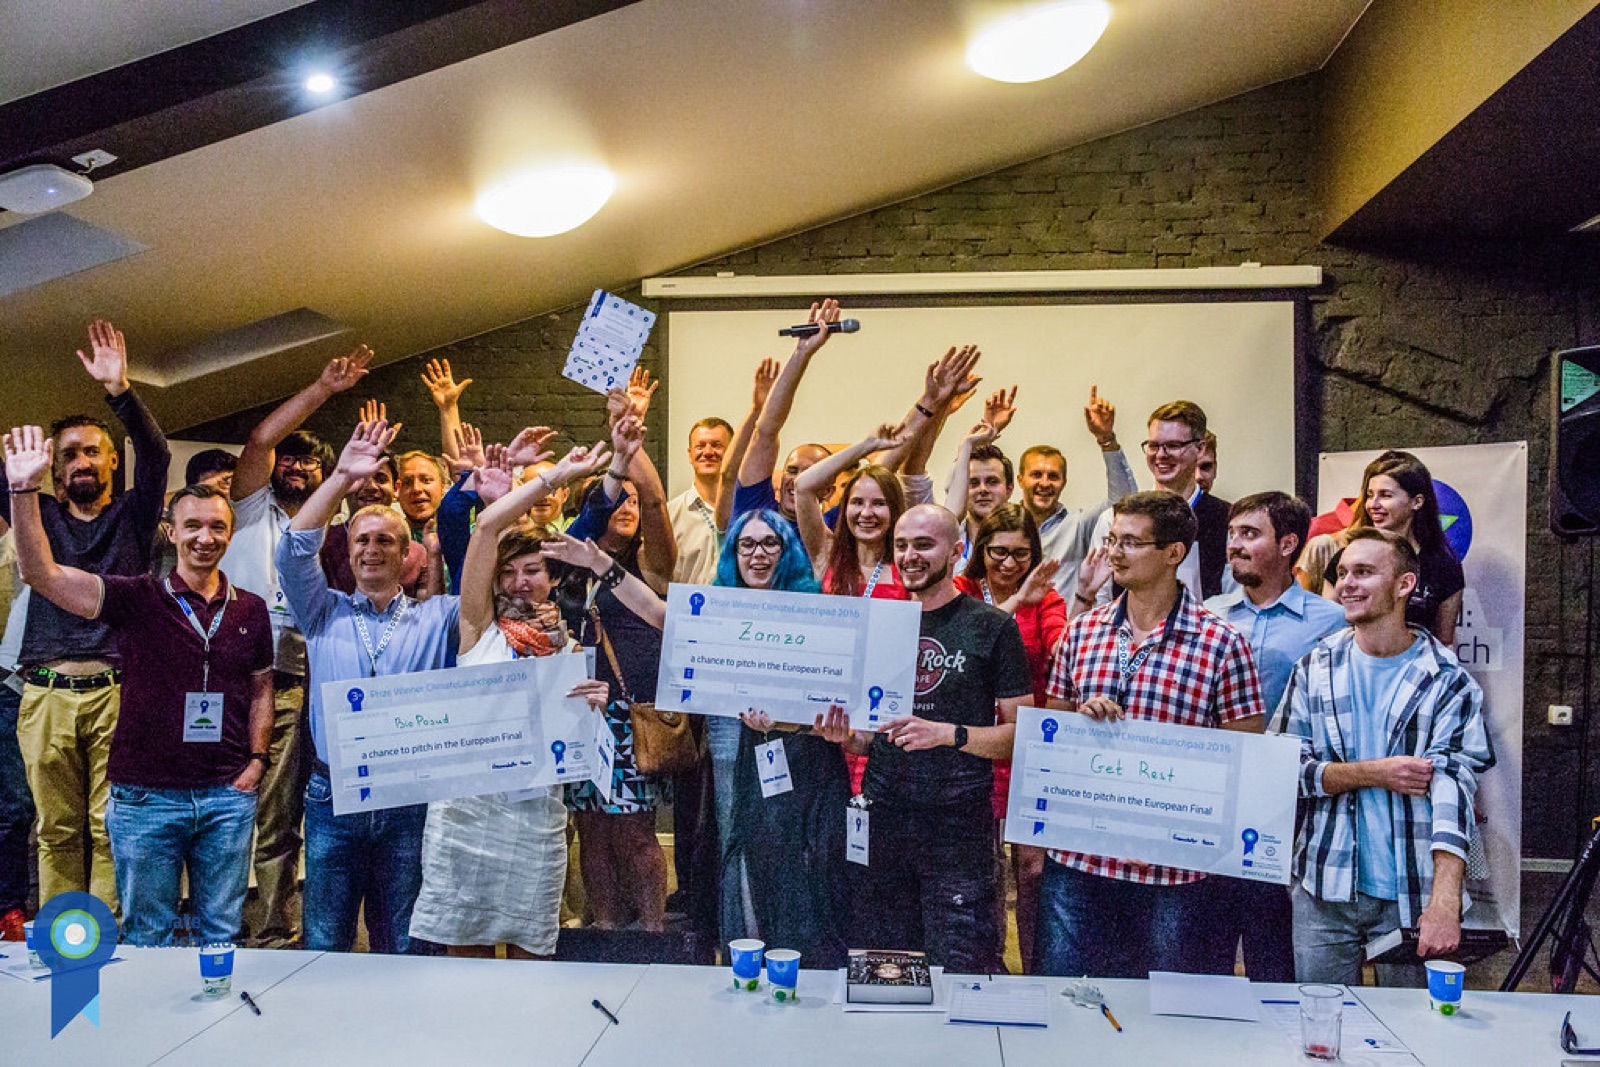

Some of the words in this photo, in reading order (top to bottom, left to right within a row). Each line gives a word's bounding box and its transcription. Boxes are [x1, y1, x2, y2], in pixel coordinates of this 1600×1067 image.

[710, 598, 728, 606] Prize
[732, 600, 760, 610] Winner
[922, 649, 966, 672] Rock
[1457, 636, 1490, 664] ch
[696, 656, 726, 666] chance
[726, 658, 734, 666] to
[736, 660, 756, 668] pitch
[766, 662, 781, 670] the
[782, 662, 820, 674] European
[822, 666, 842, 676] Final
[370, 690, 392, 698] Prize
[393, 686, 424, 695] Winner
[506, 672, 528, 683] 2016
[1064, 724, 1086, 735] Prize
[361, 752, 368, 760] a
[368, 748, 400, 758] chance
[400, 746, 410, 754] to
[412, 743, 434, 755] pitch
[434, 742, 443, 750] in
[444, 740, 458, 748] the
[460, 735, 500, 747] European
[502, 730, 522, 740] Final
[1090, 753, 1123, 776] Get
[1138, 760, 1175, 782] Rest
[1050, 786, 1082, 798] chance
[1082, 790, 1092, 799] to
[1094, 791, 1116, 802] pitch
[1116, 794, 1126, 804] in
[1127, 796, 1143, 806] the
[1144, 798, 1188, 812] European
[1190, 804, 1213, 816] Final
